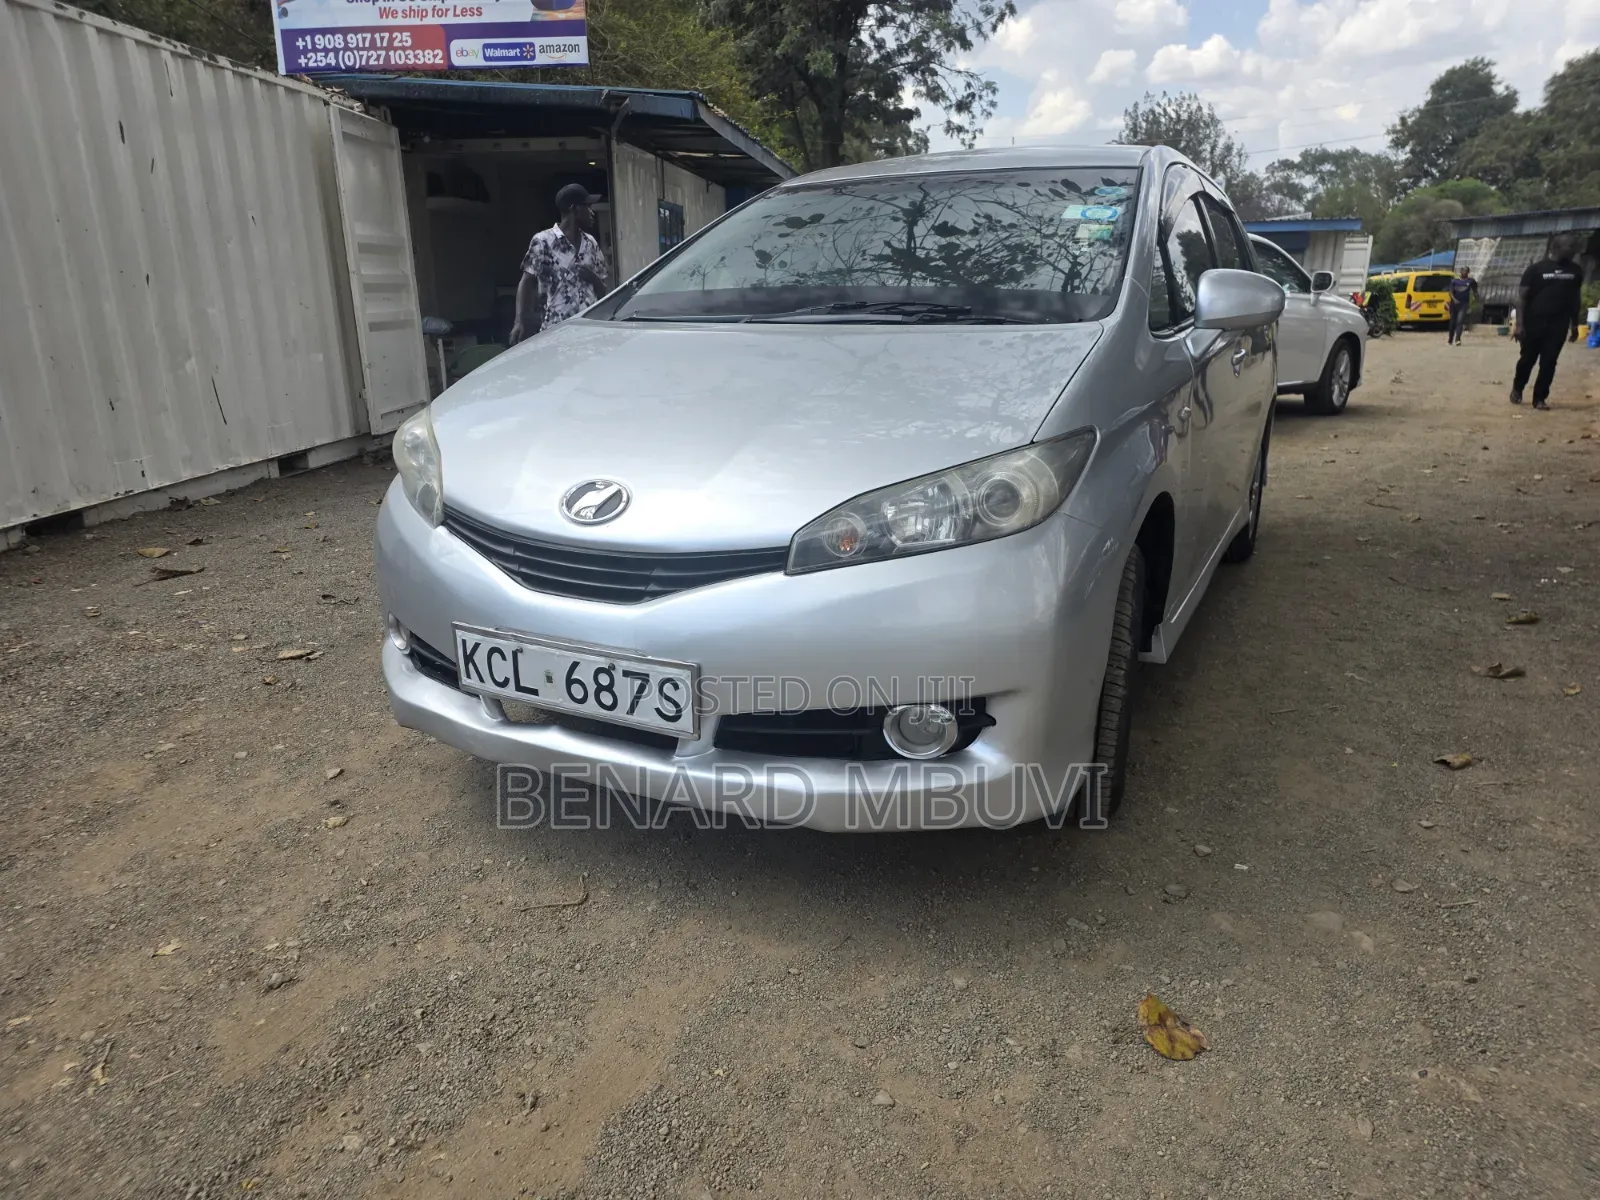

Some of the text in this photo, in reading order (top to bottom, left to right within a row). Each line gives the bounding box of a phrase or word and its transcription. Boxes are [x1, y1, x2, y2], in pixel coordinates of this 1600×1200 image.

[378, 5, 483, 21] We ship for Less
[295, 32, 412, 50] +1 908 917 17 25
[539, 43, 580, 54] amazon
[298, 49, 444, 69] +254 (0)727 103382
[455, 47, 479, 58] ebay
[484, 48, 520, 57] Walmart
[461, 638, 684, 723] KCL 687S
